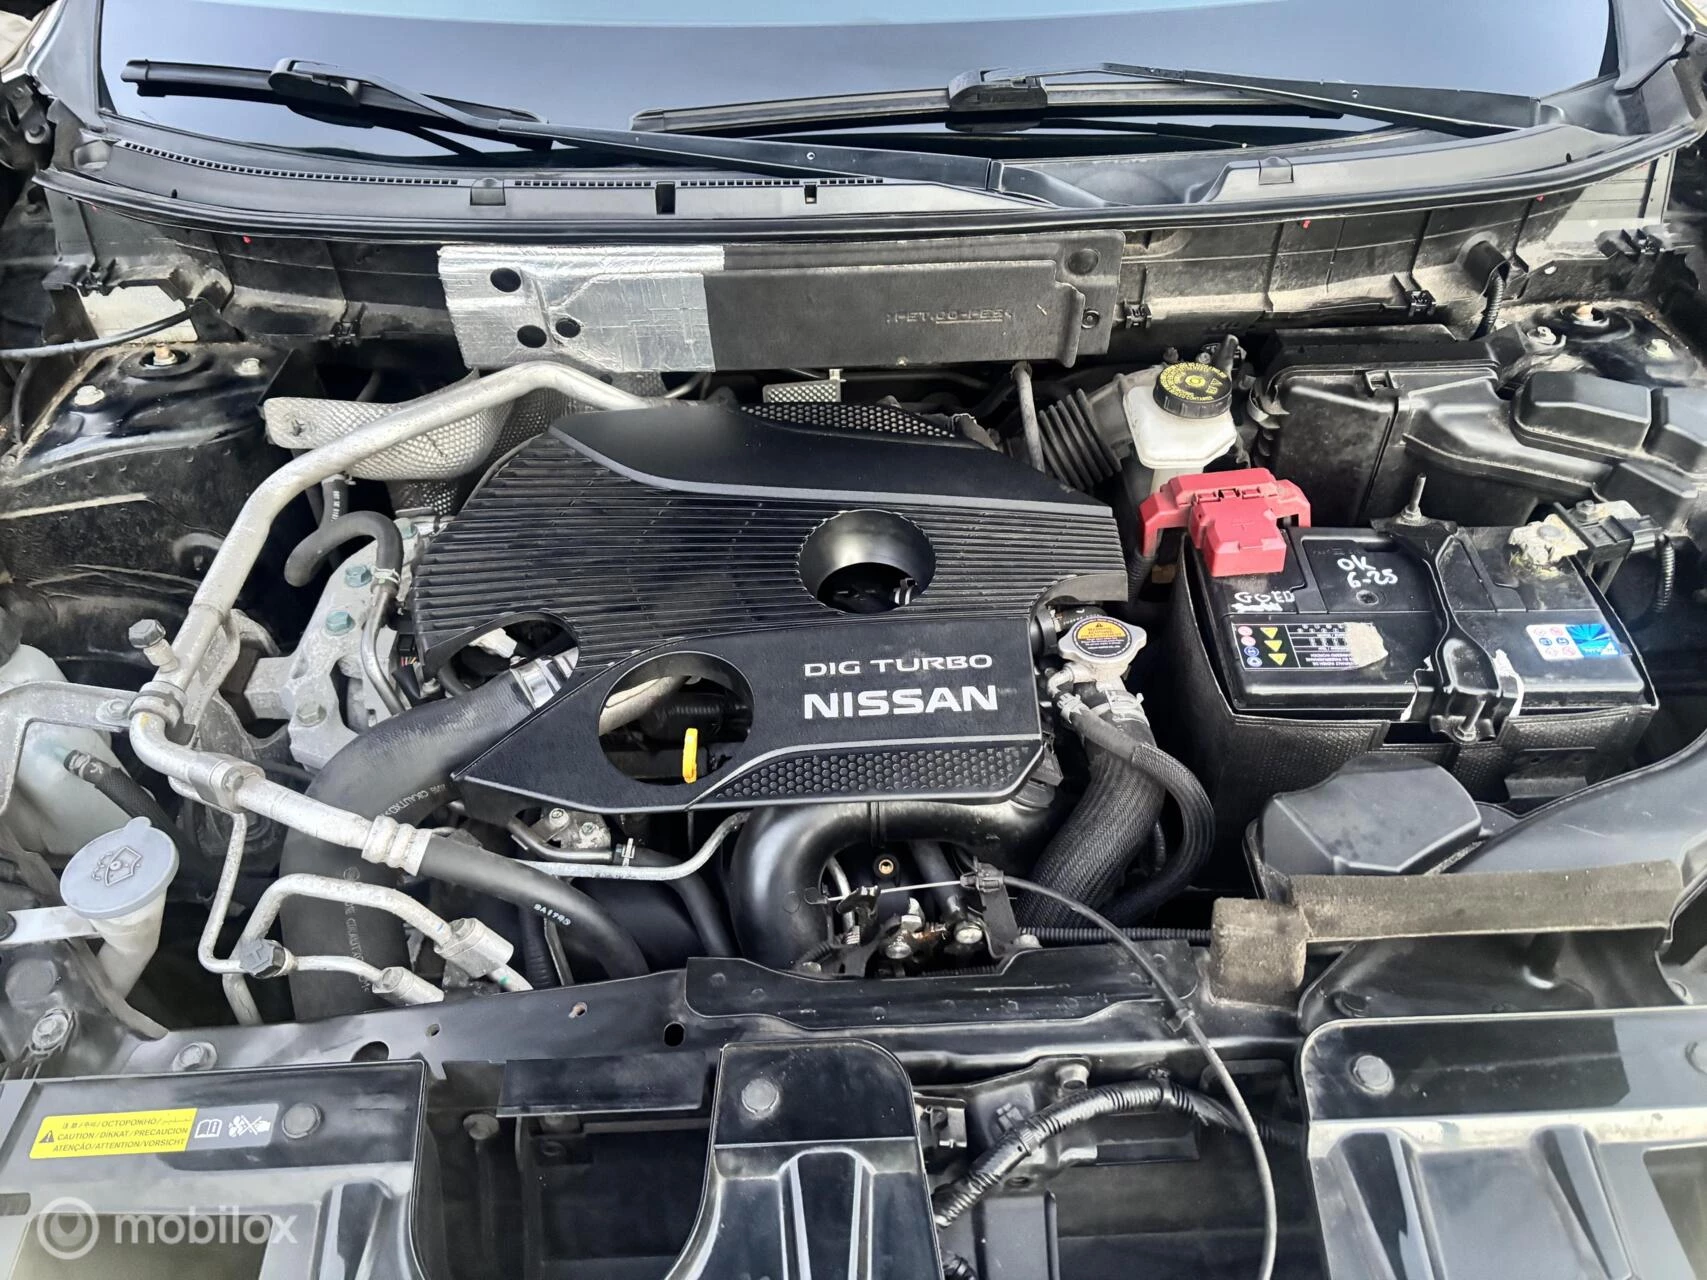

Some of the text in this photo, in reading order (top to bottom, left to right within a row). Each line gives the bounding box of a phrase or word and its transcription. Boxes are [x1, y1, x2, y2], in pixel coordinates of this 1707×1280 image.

[1337, 554, 1376, 571] OK
[804, 654, 993, 677] DIG TURBO
[804, 685, 998, 719] NISSAN
